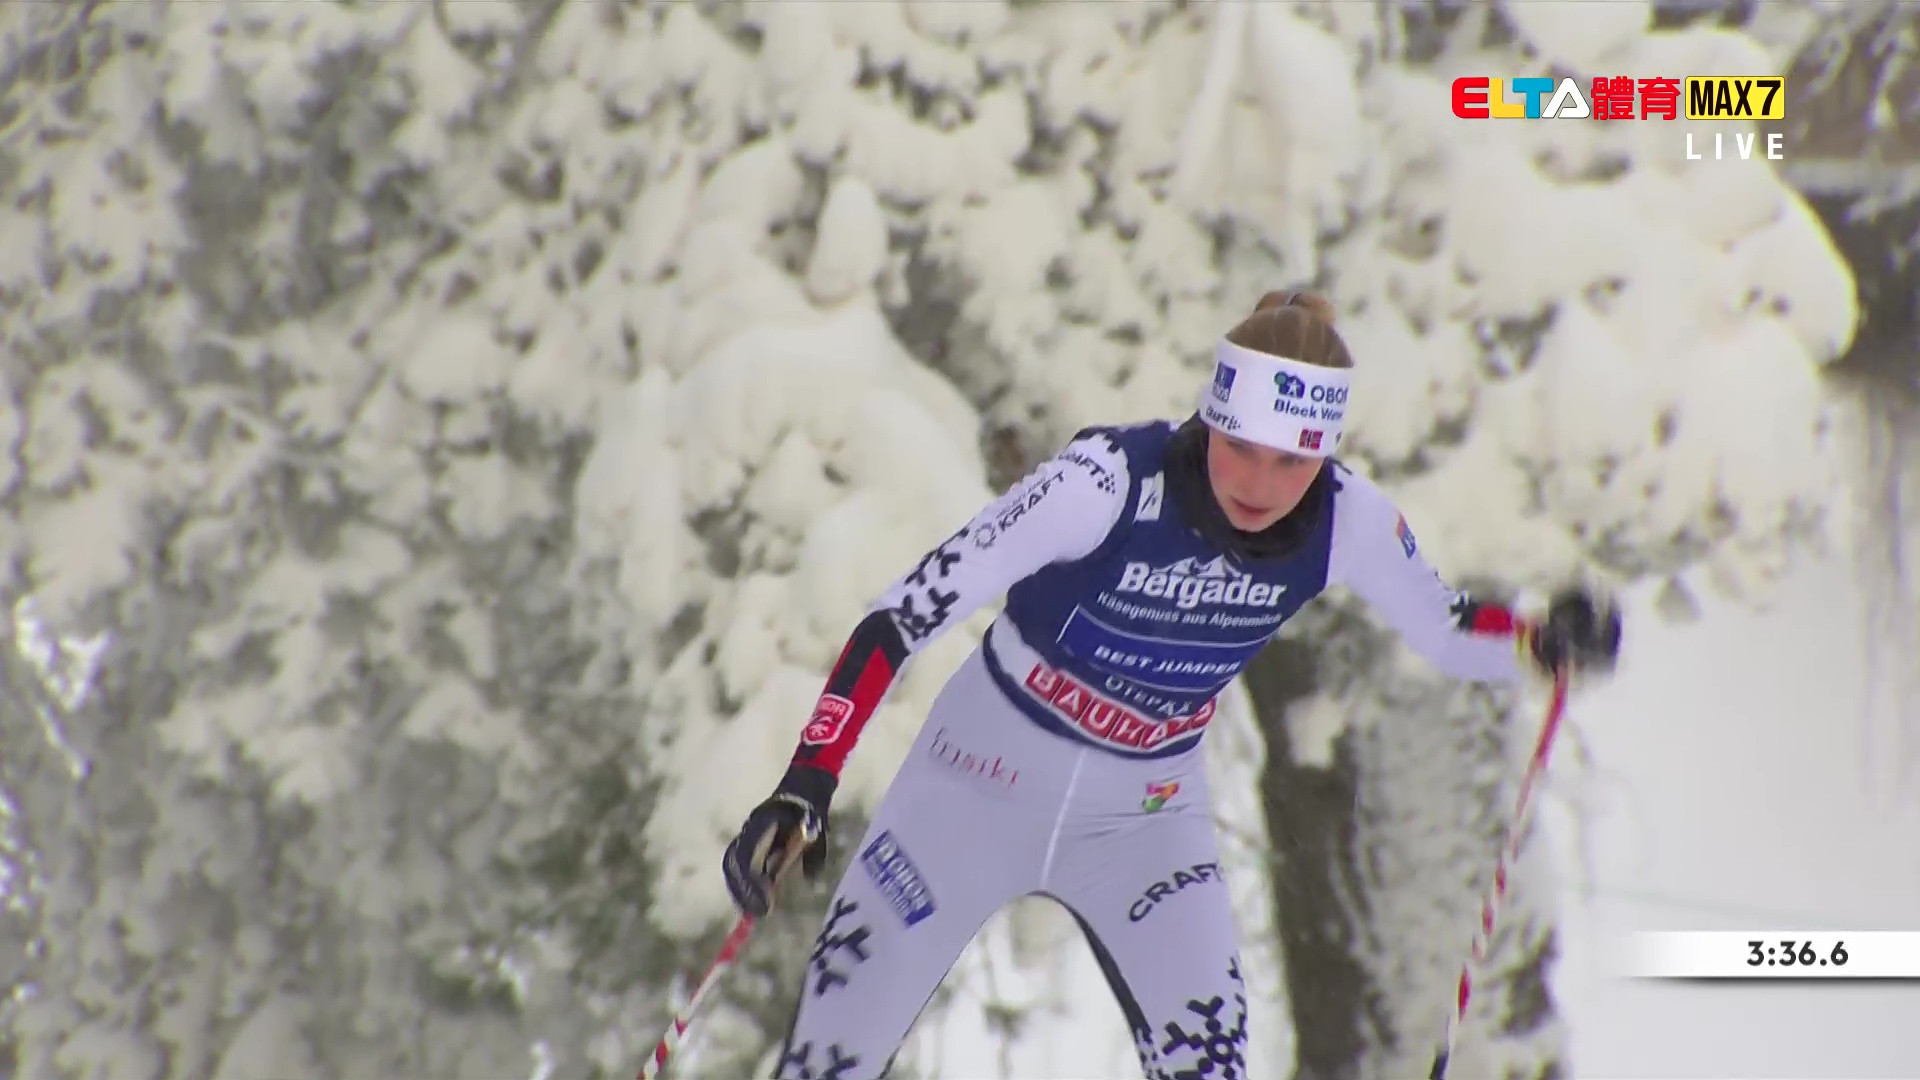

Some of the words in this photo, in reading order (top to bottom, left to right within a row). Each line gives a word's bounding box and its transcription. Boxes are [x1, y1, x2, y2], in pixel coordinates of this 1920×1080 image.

[1310, 385, 1349, 404] OBO
[1273, 398, 1317, 418] Block
[998, 470, 1065, 532] KRAFT
[1116, 561, 1287, 609] Bergader
[1181, 612, 1208, 625] aus
[1208, 611, 1283, 630] Alpenmilch
[1094, 645, 1153, 669] BEST
[1152, 660, 1242, 675] JUMPER
